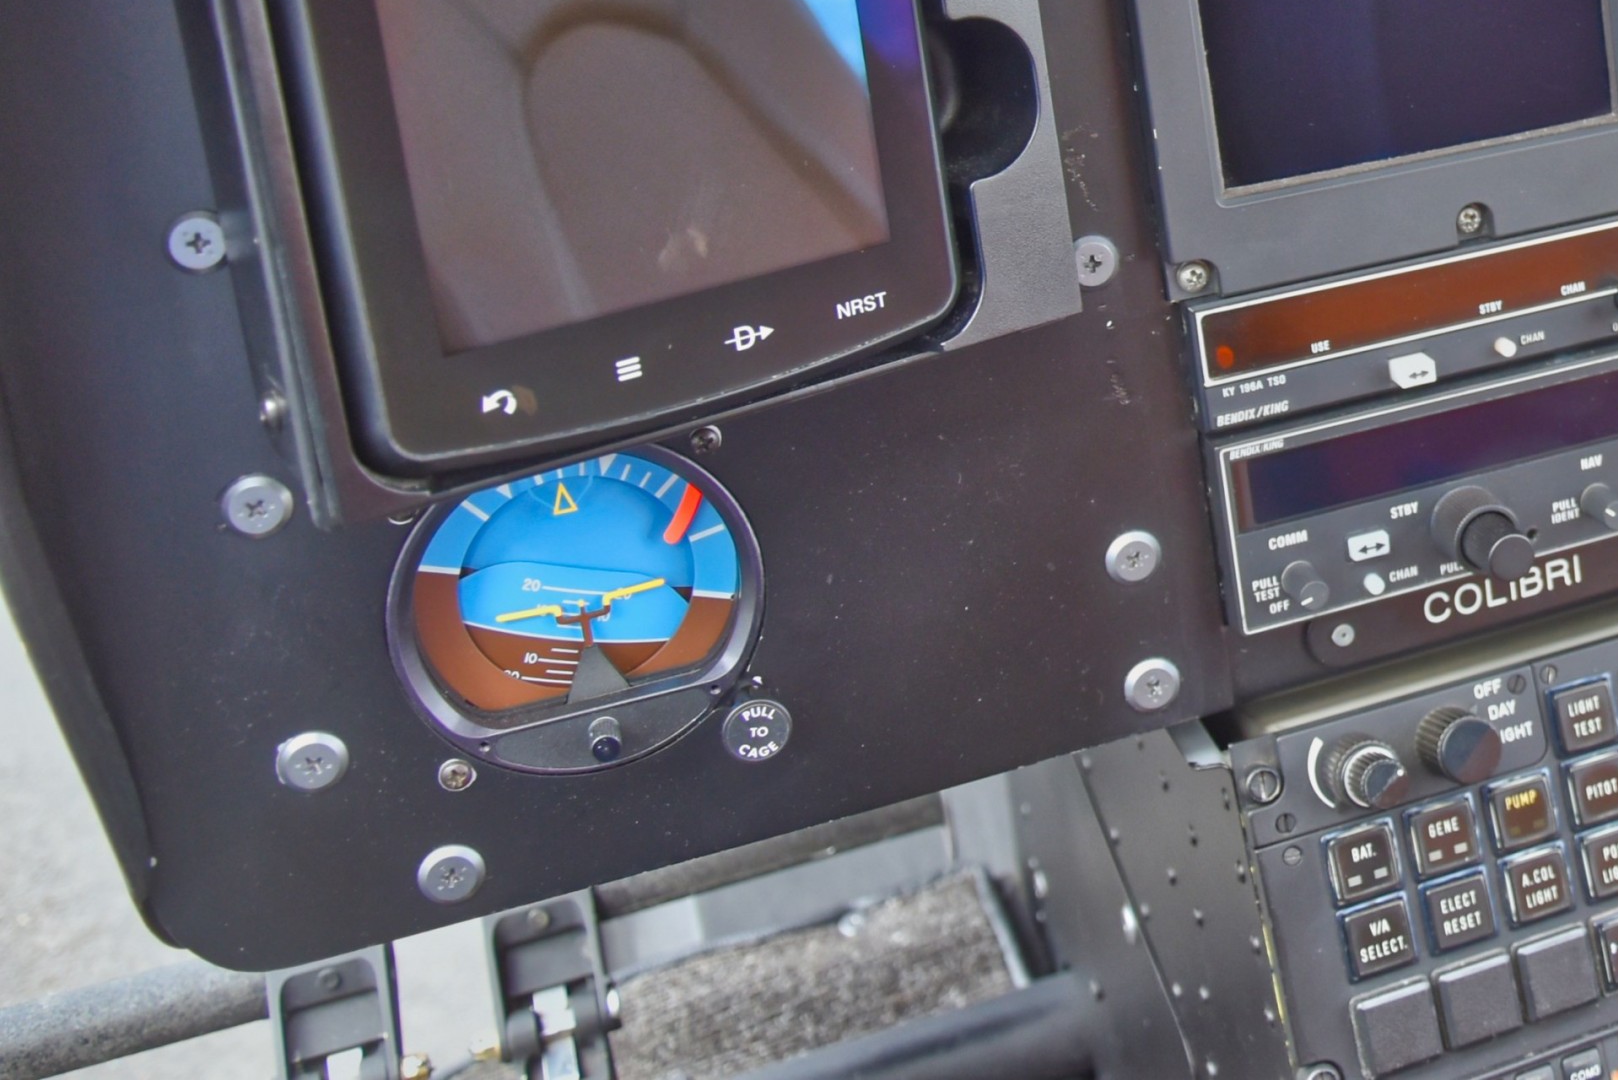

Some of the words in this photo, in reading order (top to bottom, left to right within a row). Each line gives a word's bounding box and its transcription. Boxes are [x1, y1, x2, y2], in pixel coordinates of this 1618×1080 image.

[1560, 281, 1585, 296] CHAN
[836, 291, 887, 320] NRST
[1479, 300, 1503, 315] STBY
[1311, 340, 1330, 353] USE
[1520, 331, 1545, 346] CHAN
[1222, 387, 1237, 398] KY
[1267, 375, 1287, 388] TSO
[1216, 400, 1289, 428] BENDIX/KING
[1580, 454, 1603, 471] NAV
[1390, 502, 1418, 520] STBY
[1552, 497, 1577, 513] PULL
[1551, 507, 1581, 525] IDENT
[1268, 529, 1308, 551] COMM
[1389, 566, 1418, 582] CHAN
[1440, 562, 1464, 575] PUL
[522, 578, 541, 592] 20
[1252, 576, 1280, 592] PULL
[1424, 554, 1582, 624] COLIBRI
[1254, 587, 1280, 603] TEST
[1269, 600, 1290, 615] OFF
[524, 652, 539, 664] 10
[1473, 678, 1502, 700] OFF
[742, 706, 776, 721] PULL
[1488, 699, 1516, 721] DAY
[1567, 695, 1600, 719] LIGHT
[749, 726, 769, 738] TO
[1500, 721, 1534, 744] IGHT
[1573, 716, 1602, 738] TEST
[738, 741, 779, 759] CAGE
[1585, 777, 1618, 801] PITOT
[1505, 789, 1537, 810] PUMP
[1428, 816, 1459, 838] GENE
[1351, 842, 1377, 863] BAT.
[1521, 864, 1556, 888] A.COL
[1440, 890, 1477, 914] ELECT
[1525, 886, 1559, 909] LIGHT
[1369, 918, 1391, 937] V/A
[1444, 911, 1482, 936] RESET
[1360, 937, 1408, 963] SELECT.
